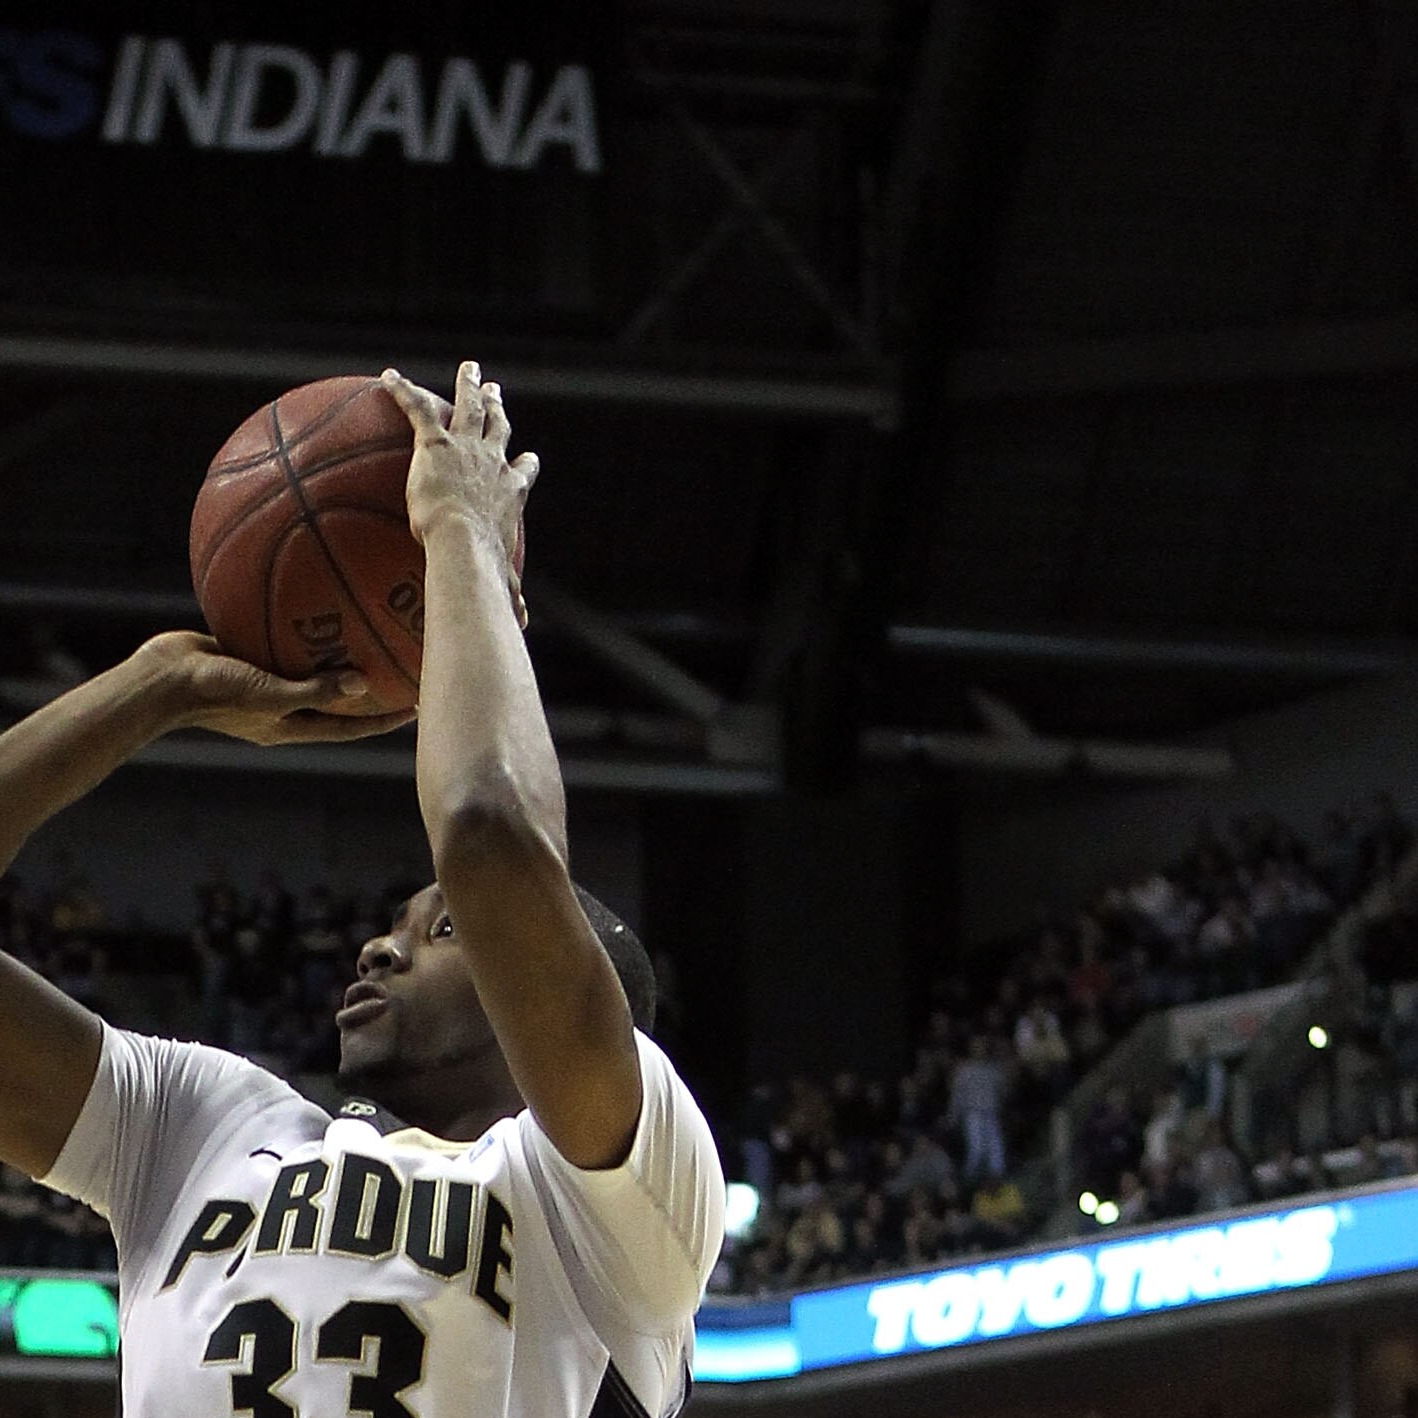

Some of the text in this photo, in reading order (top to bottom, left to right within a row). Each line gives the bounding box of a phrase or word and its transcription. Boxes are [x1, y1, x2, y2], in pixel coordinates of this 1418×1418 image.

[101, 33, 603, 174] INDIANA
[153, 1150, 514, 1327] PRDUE
[867, 1205, 1339, 1354] TOYO TIRES
